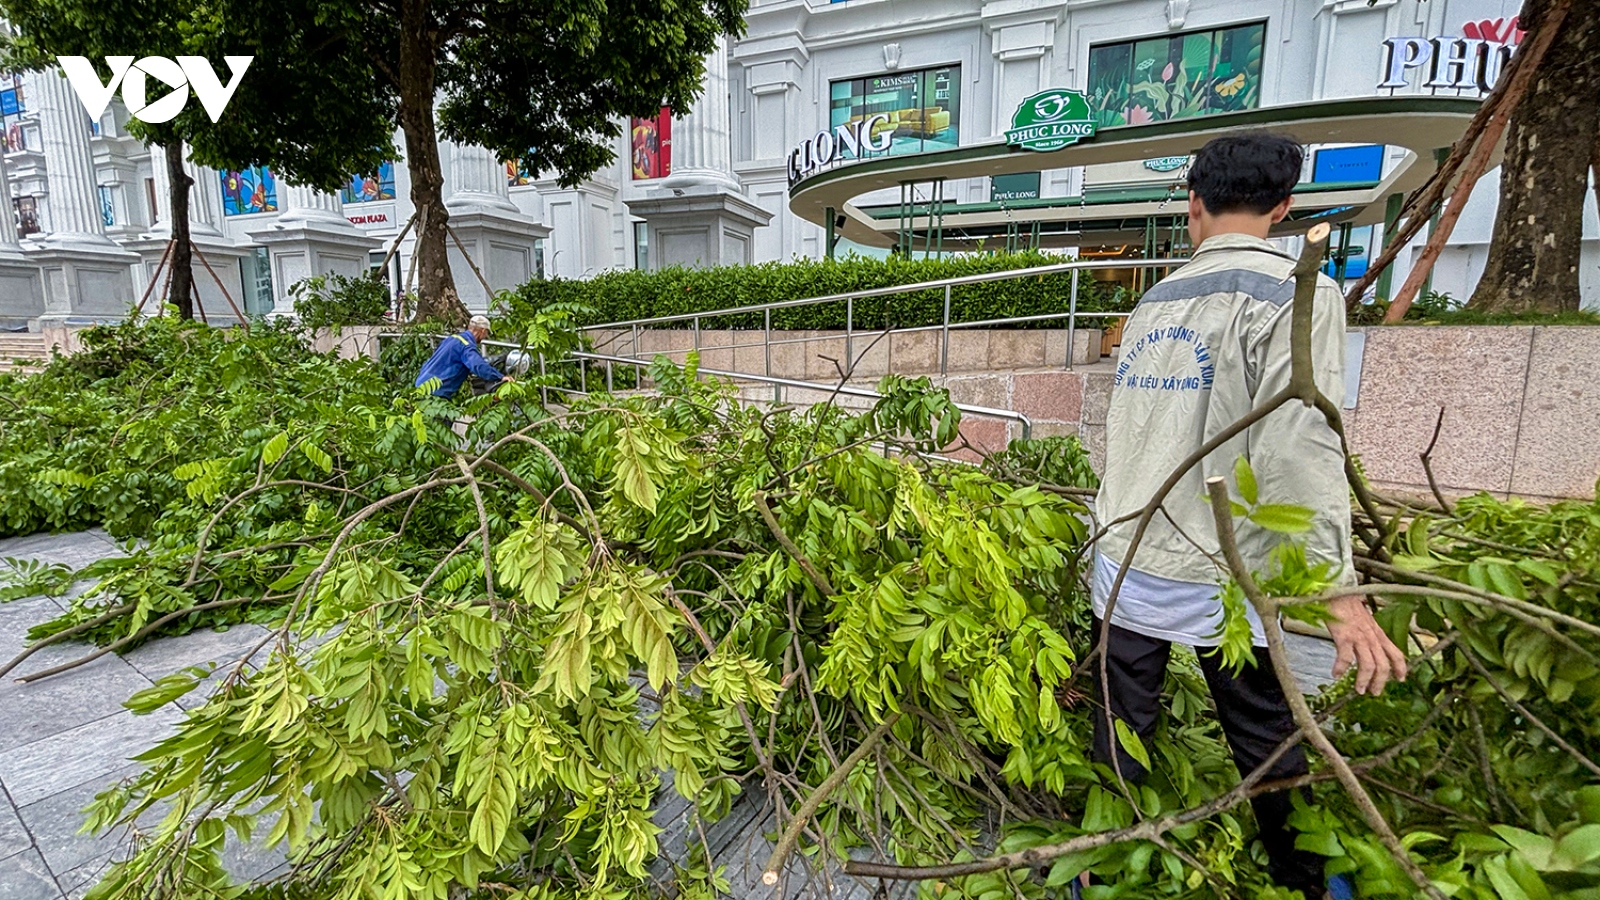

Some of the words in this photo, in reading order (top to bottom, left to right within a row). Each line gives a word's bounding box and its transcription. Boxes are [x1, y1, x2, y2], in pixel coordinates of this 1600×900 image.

[1009, 126, 1049, 143] PHUC
[1051, 123, 1093, 136] LONG
[800, 113, 895, 175] LONG
[1016, 191, 1036, 199] LONG
[1126, 348, 1137, 362] TY
[1147, 328, 1167, 344] XÂY
[1167, 326, 1194, 342] DỰNG
[1160, 375, 1182, 391] XÂY
